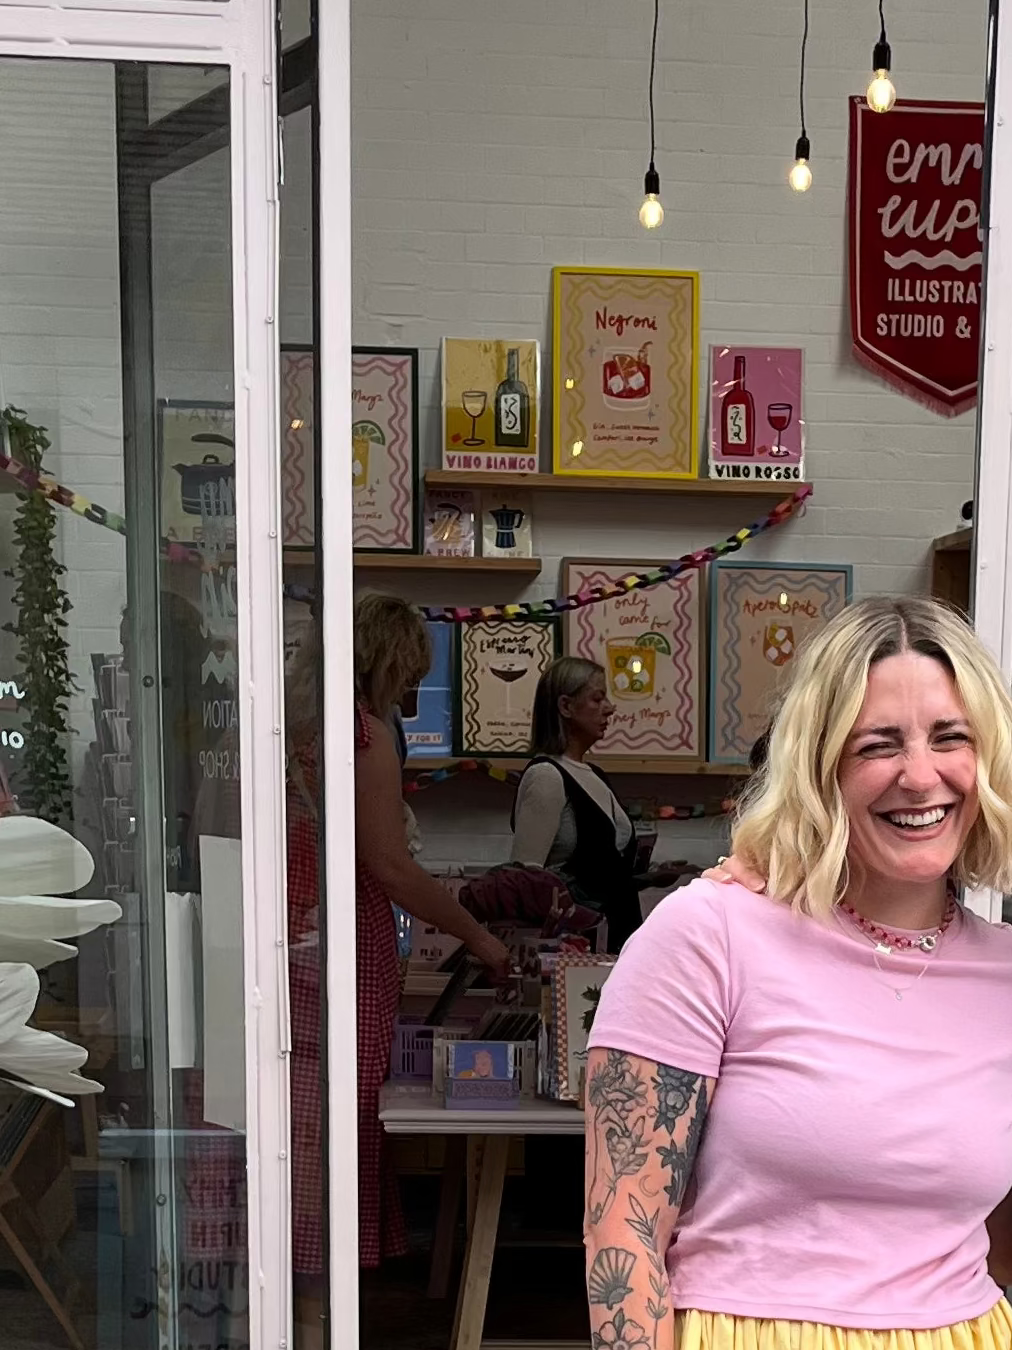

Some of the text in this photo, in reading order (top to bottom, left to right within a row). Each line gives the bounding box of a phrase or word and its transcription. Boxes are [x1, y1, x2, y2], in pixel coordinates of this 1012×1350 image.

[887, 278, 983, 304] ILLUSTRA
[595, 305, 658, 336] Negroni
[876, 313, 972, 338] STUDIO &
[446, 454, 536, 471] VINO BIANCO
[715, 464, 800, 480] VINO ROSSO
[614, 592, 651, 616] only
[618, 614, 650, 626] came
